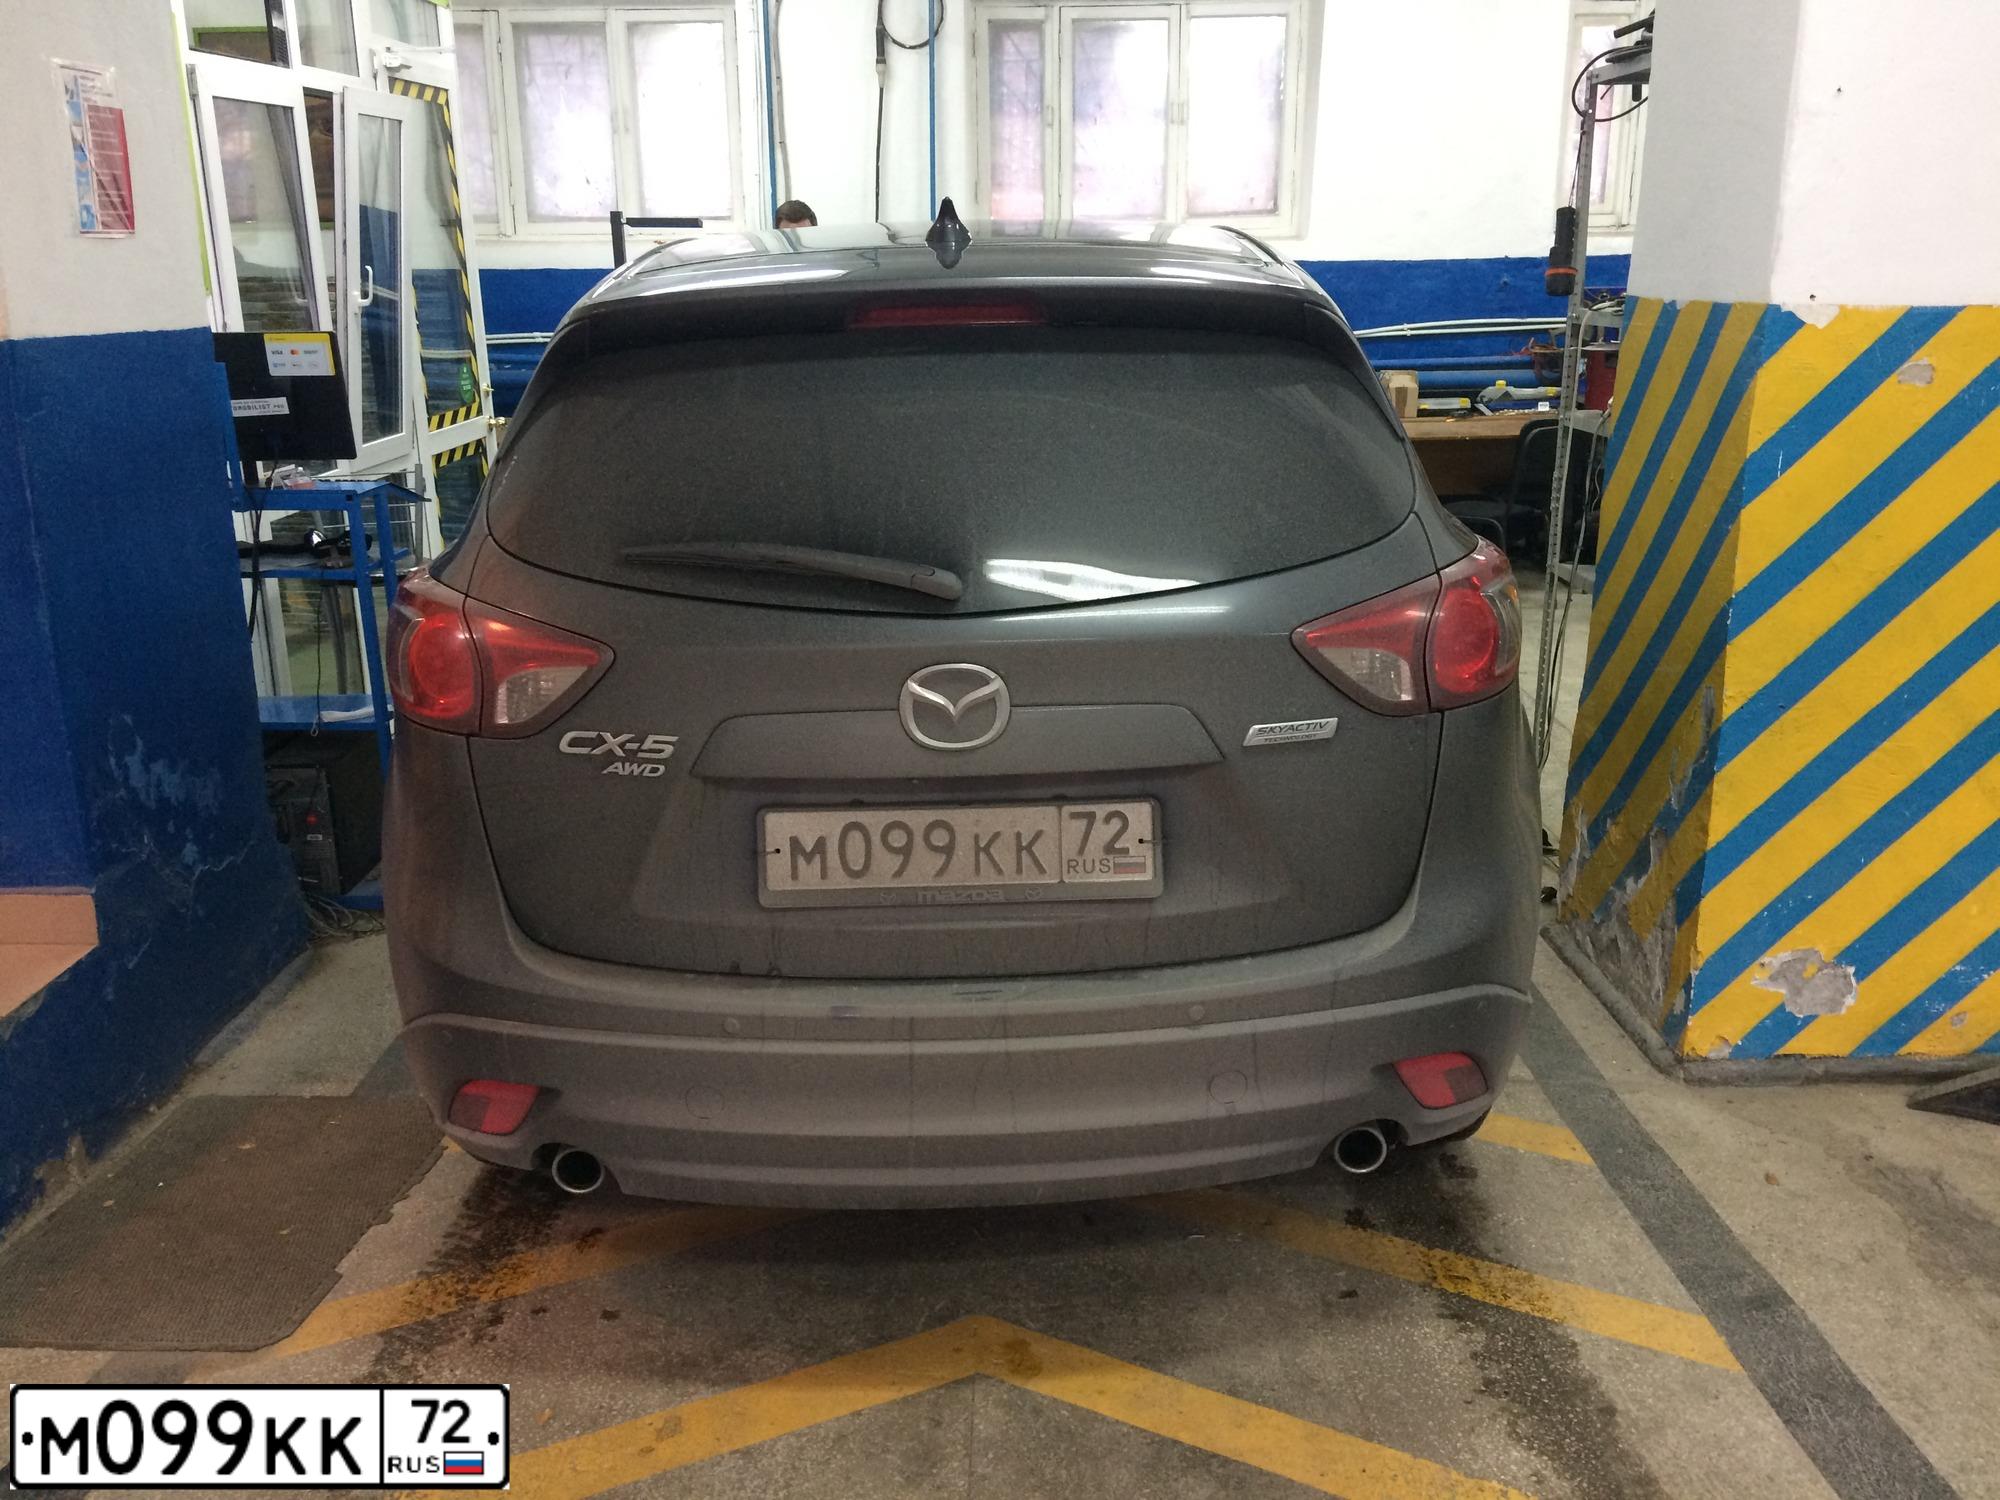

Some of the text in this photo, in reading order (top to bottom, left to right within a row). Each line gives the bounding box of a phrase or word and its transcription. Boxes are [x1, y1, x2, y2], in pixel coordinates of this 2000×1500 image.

[1256, 721, 1329, 736] SKYACTIV
[559, 731, 679, 759] CX-5
[601, 762, 666, 777] AWD
[1069, 810, 1130, 856] 72
[1067, 857, 1111, 874] RUS
